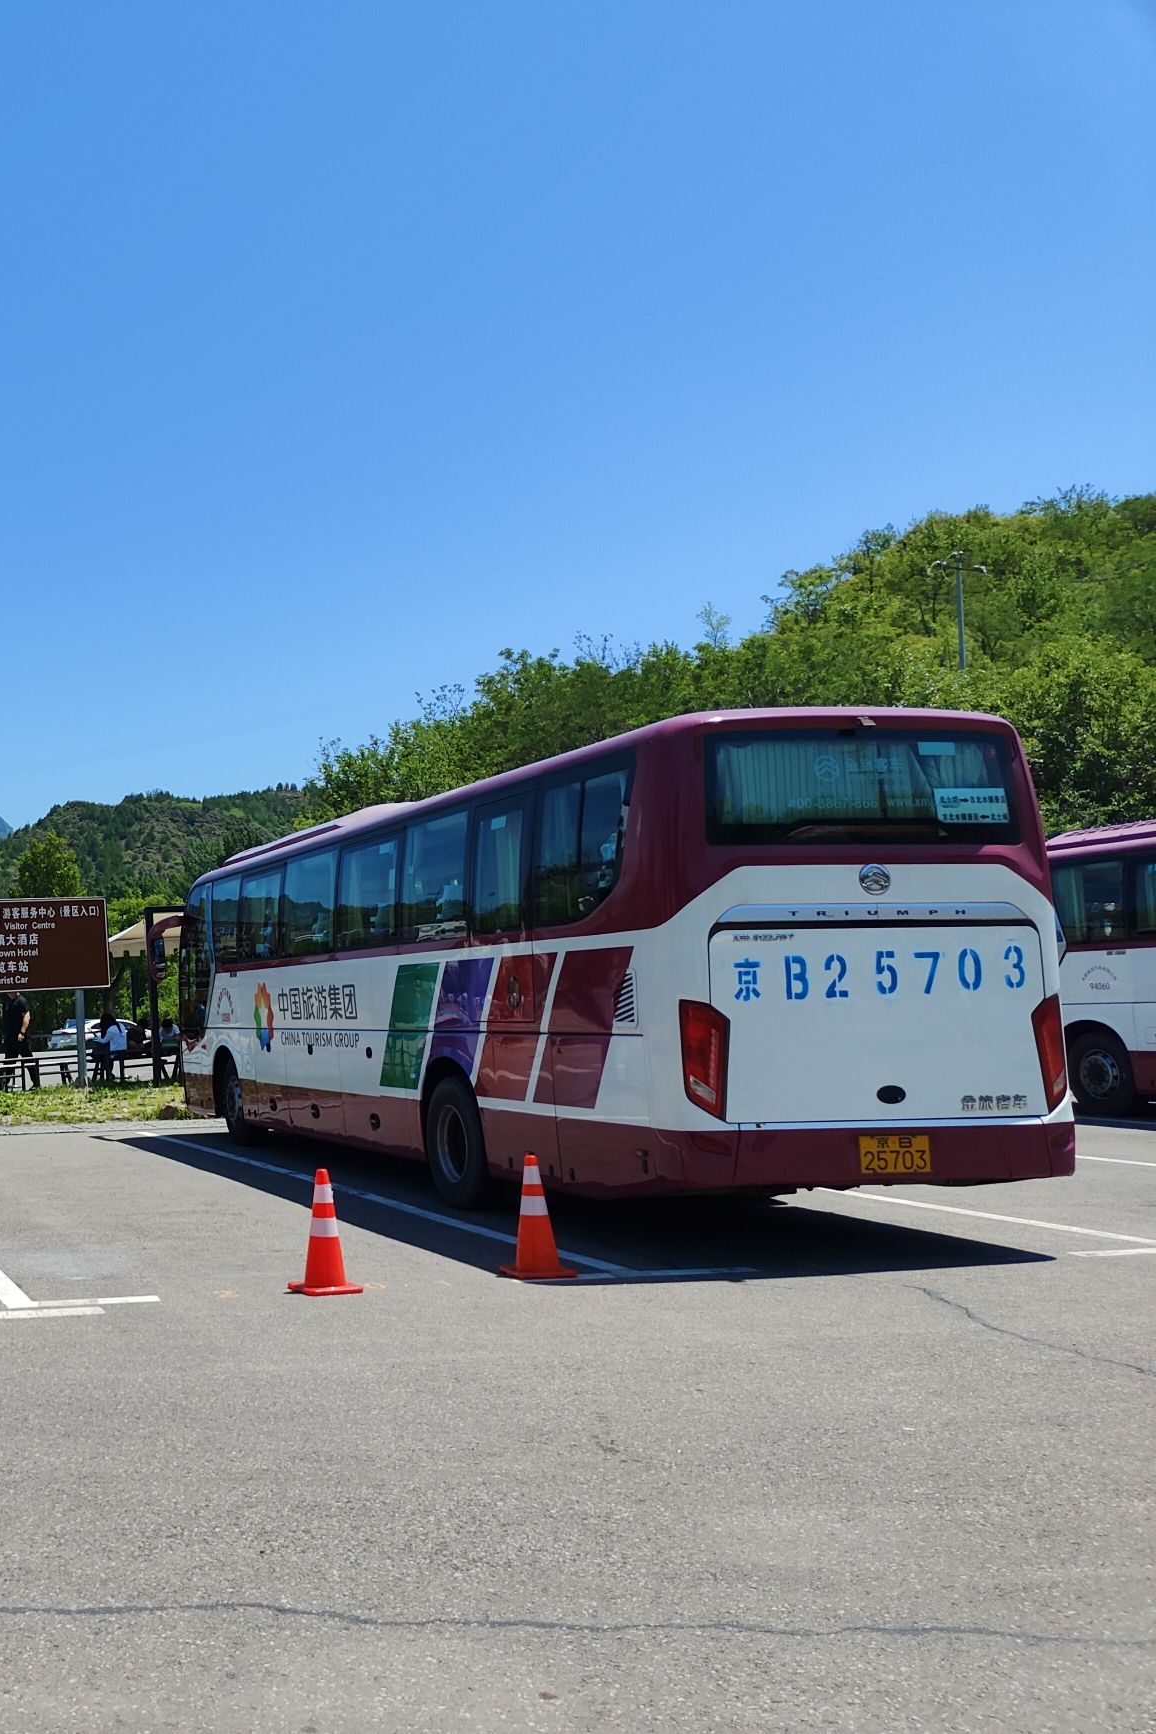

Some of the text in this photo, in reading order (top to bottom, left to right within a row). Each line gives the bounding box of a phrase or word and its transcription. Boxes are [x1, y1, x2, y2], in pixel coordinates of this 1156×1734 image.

[2, 907, 55, 919] 游客服务中心
[788, 909, 967, 917] TRIUMPH
[4, 921, 56, 930] Visitor Centre
[17, 948, 39, 957] Hotel
[15, 975, 29, 984] Car
[277, 984, 358, 1021] 中国旅游集团
[280, 1031, 360, 1049] CHINA TOURISM GROUP
[960, 1094, 1028, 1111] 金旅客车
[864, 1150, 927, 1170] 25703
